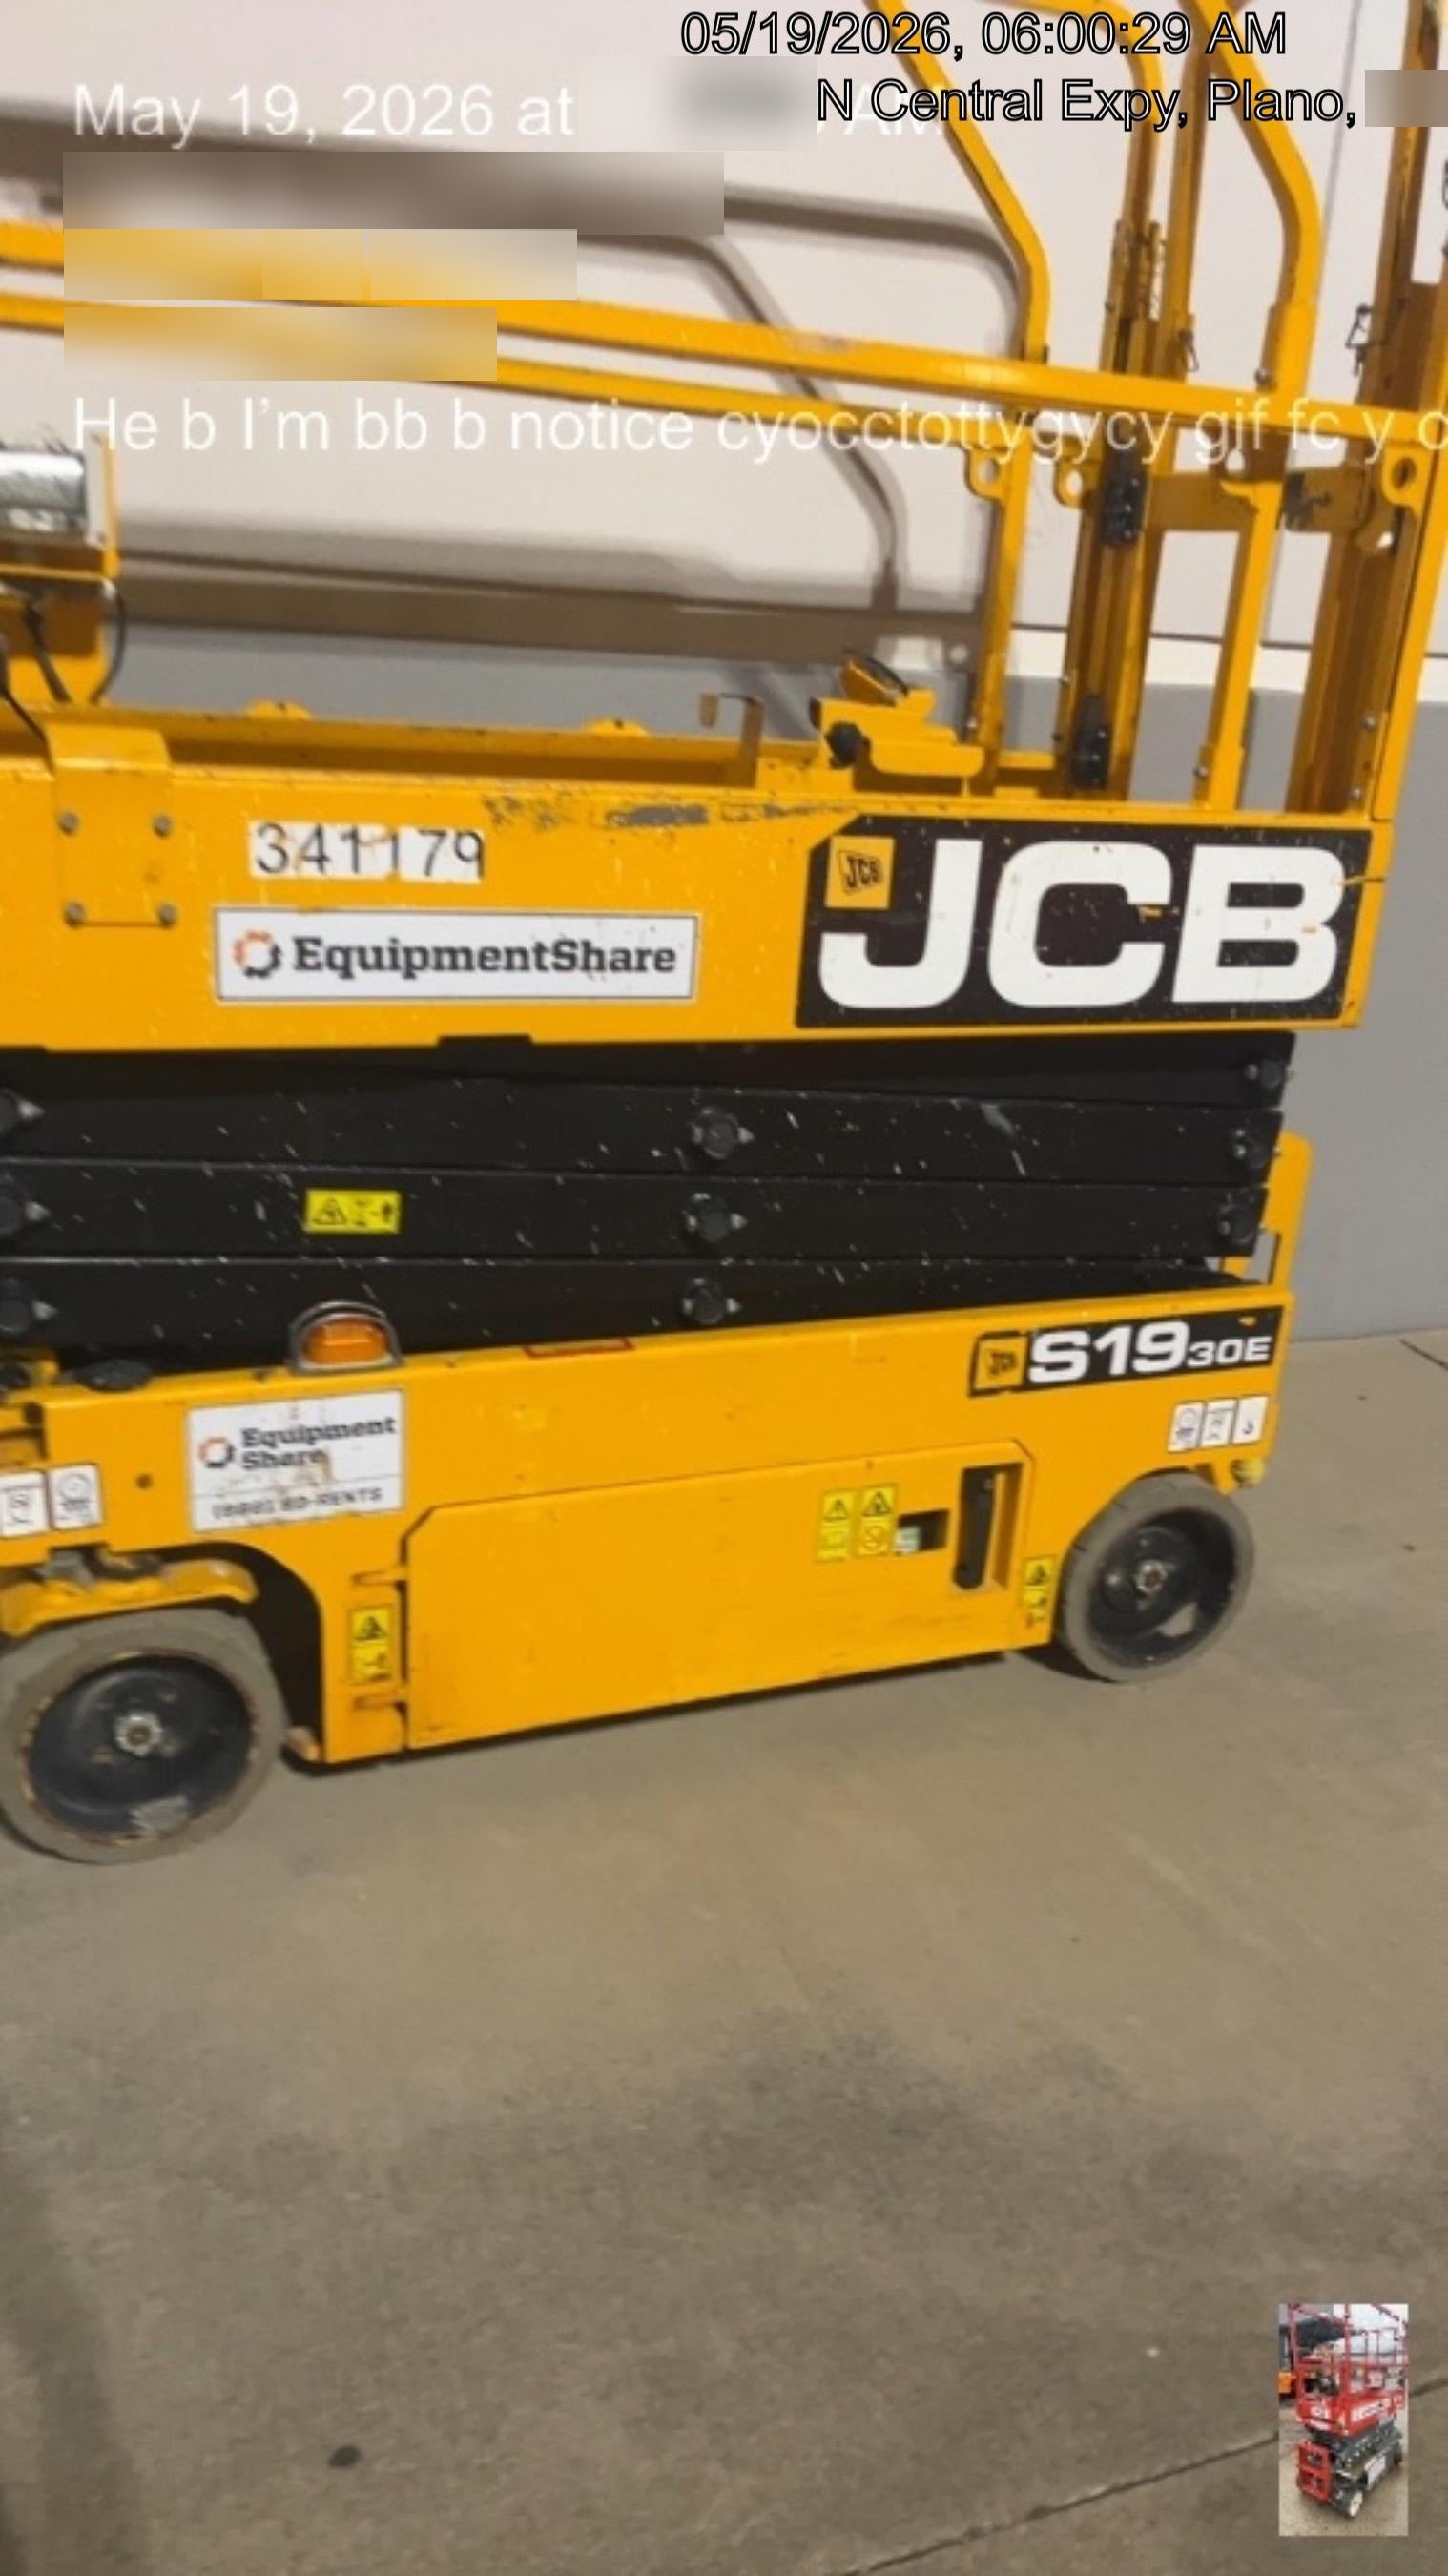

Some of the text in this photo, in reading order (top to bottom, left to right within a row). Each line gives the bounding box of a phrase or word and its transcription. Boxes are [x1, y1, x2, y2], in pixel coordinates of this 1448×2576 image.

[257, 822, 484, 876] 341179
[818, 838, 1345, 1009] JCB
[293, 937, 675, 979] EquipmentShare
[242, 1417, 396, 1448] Equipment
[242, 1449, 329, 1469] Share
